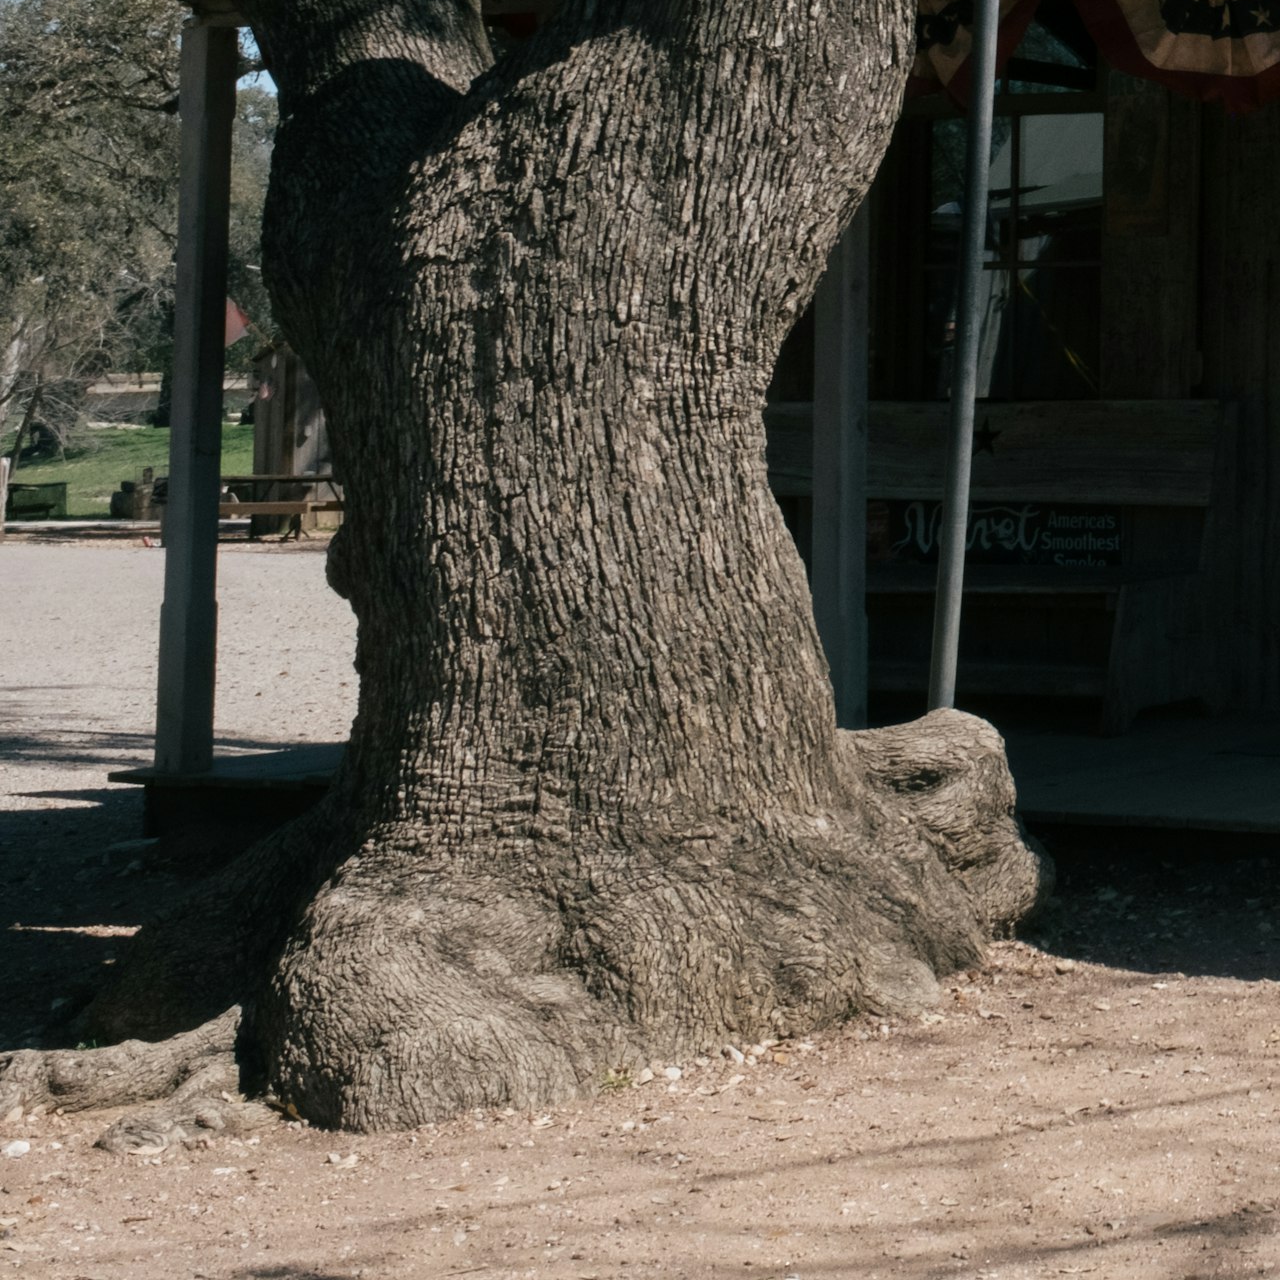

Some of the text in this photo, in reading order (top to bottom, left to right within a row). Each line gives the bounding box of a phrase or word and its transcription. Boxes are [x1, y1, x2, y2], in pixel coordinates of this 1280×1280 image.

[891, 502, 1040, 554] Vvet
[1048, 511, 1116, 529] America's
[1040, 532, 1121, 551] Smoothest
